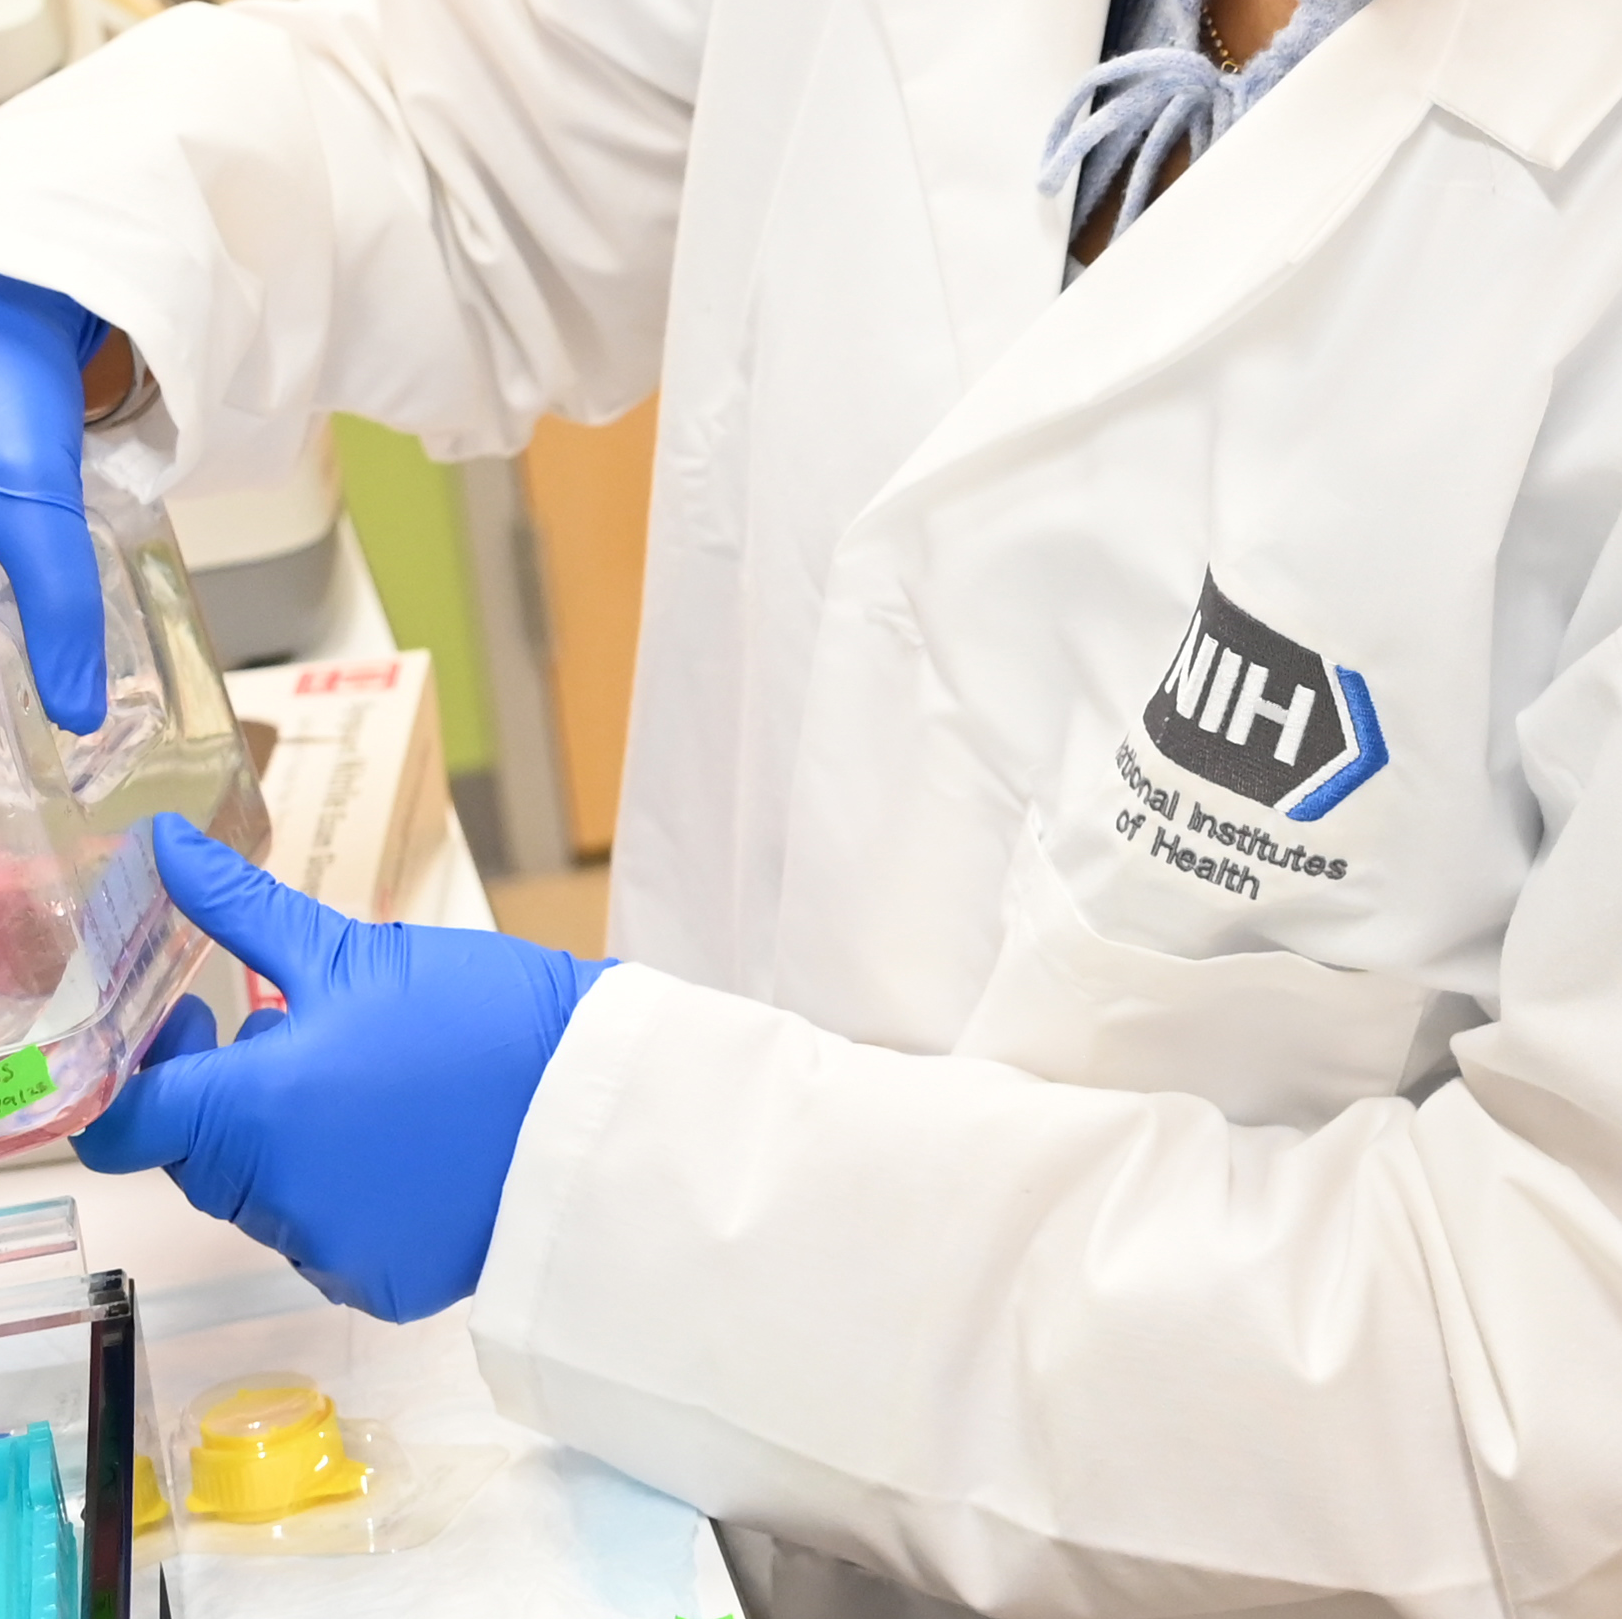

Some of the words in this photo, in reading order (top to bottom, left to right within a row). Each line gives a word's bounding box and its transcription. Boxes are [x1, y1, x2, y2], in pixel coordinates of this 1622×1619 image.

[1165, 610, 1317, 767] NIH
[1115, 732, 1180, 822] ational
[1187, 801, 1348, 880] Institutes
[1115, 807, 1147, 842] of
[1149, 827, 1261, 900] Health
